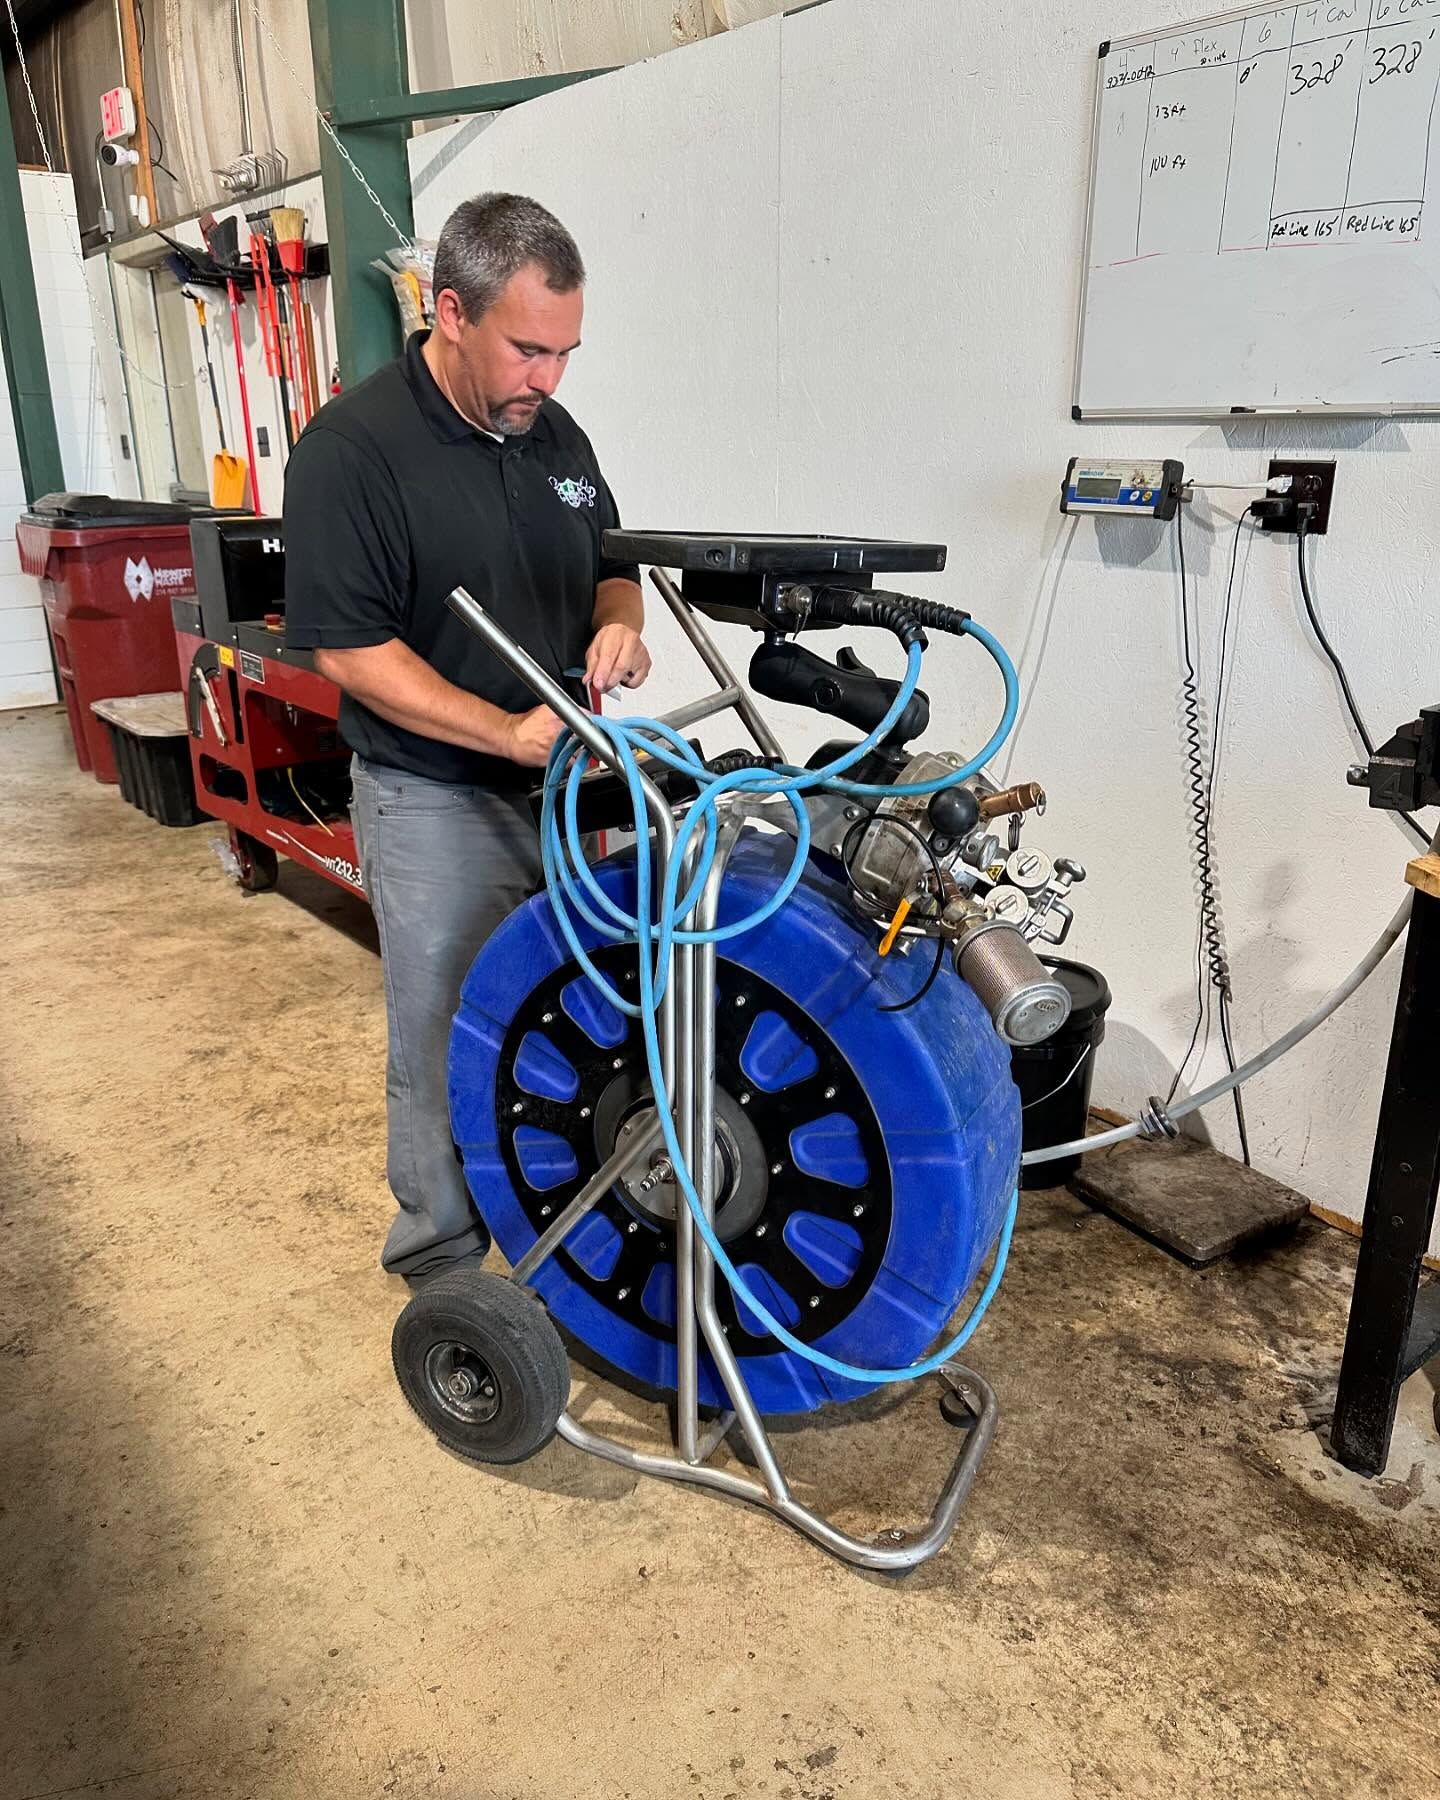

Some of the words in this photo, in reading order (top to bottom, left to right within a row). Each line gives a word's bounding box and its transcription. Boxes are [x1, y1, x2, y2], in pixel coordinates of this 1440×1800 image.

[1399, 0, 1437, 14] Ca
[1290, 39, 1354, 96] 328'
[1368, 28, 1436, 85] 328'
